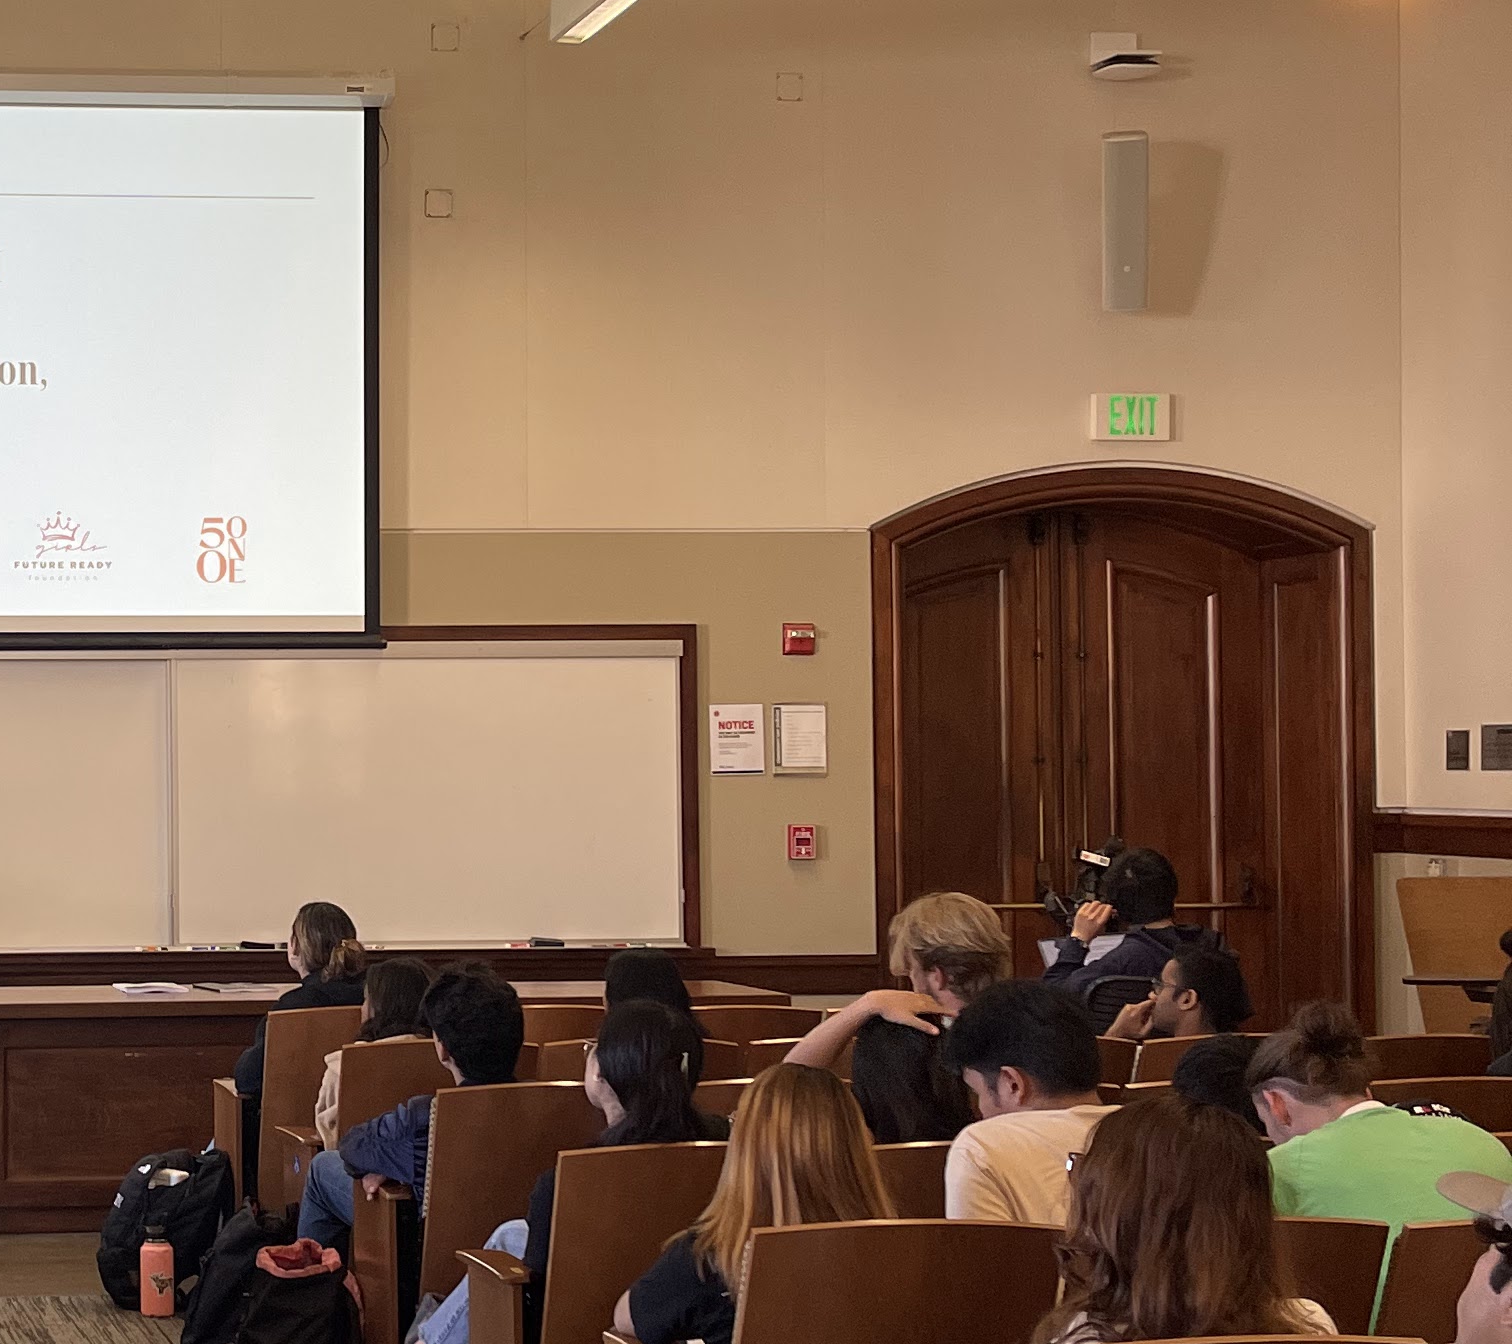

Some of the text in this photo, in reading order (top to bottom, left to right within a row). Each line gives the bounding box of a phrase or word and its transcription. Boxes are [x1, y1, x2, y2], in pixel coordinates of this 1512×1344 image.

[1109, 395, 1159, 436] EXIT
[13, 560, 113, 570] FUTURE READY
[718, 720, 755, 730] NOTICE
